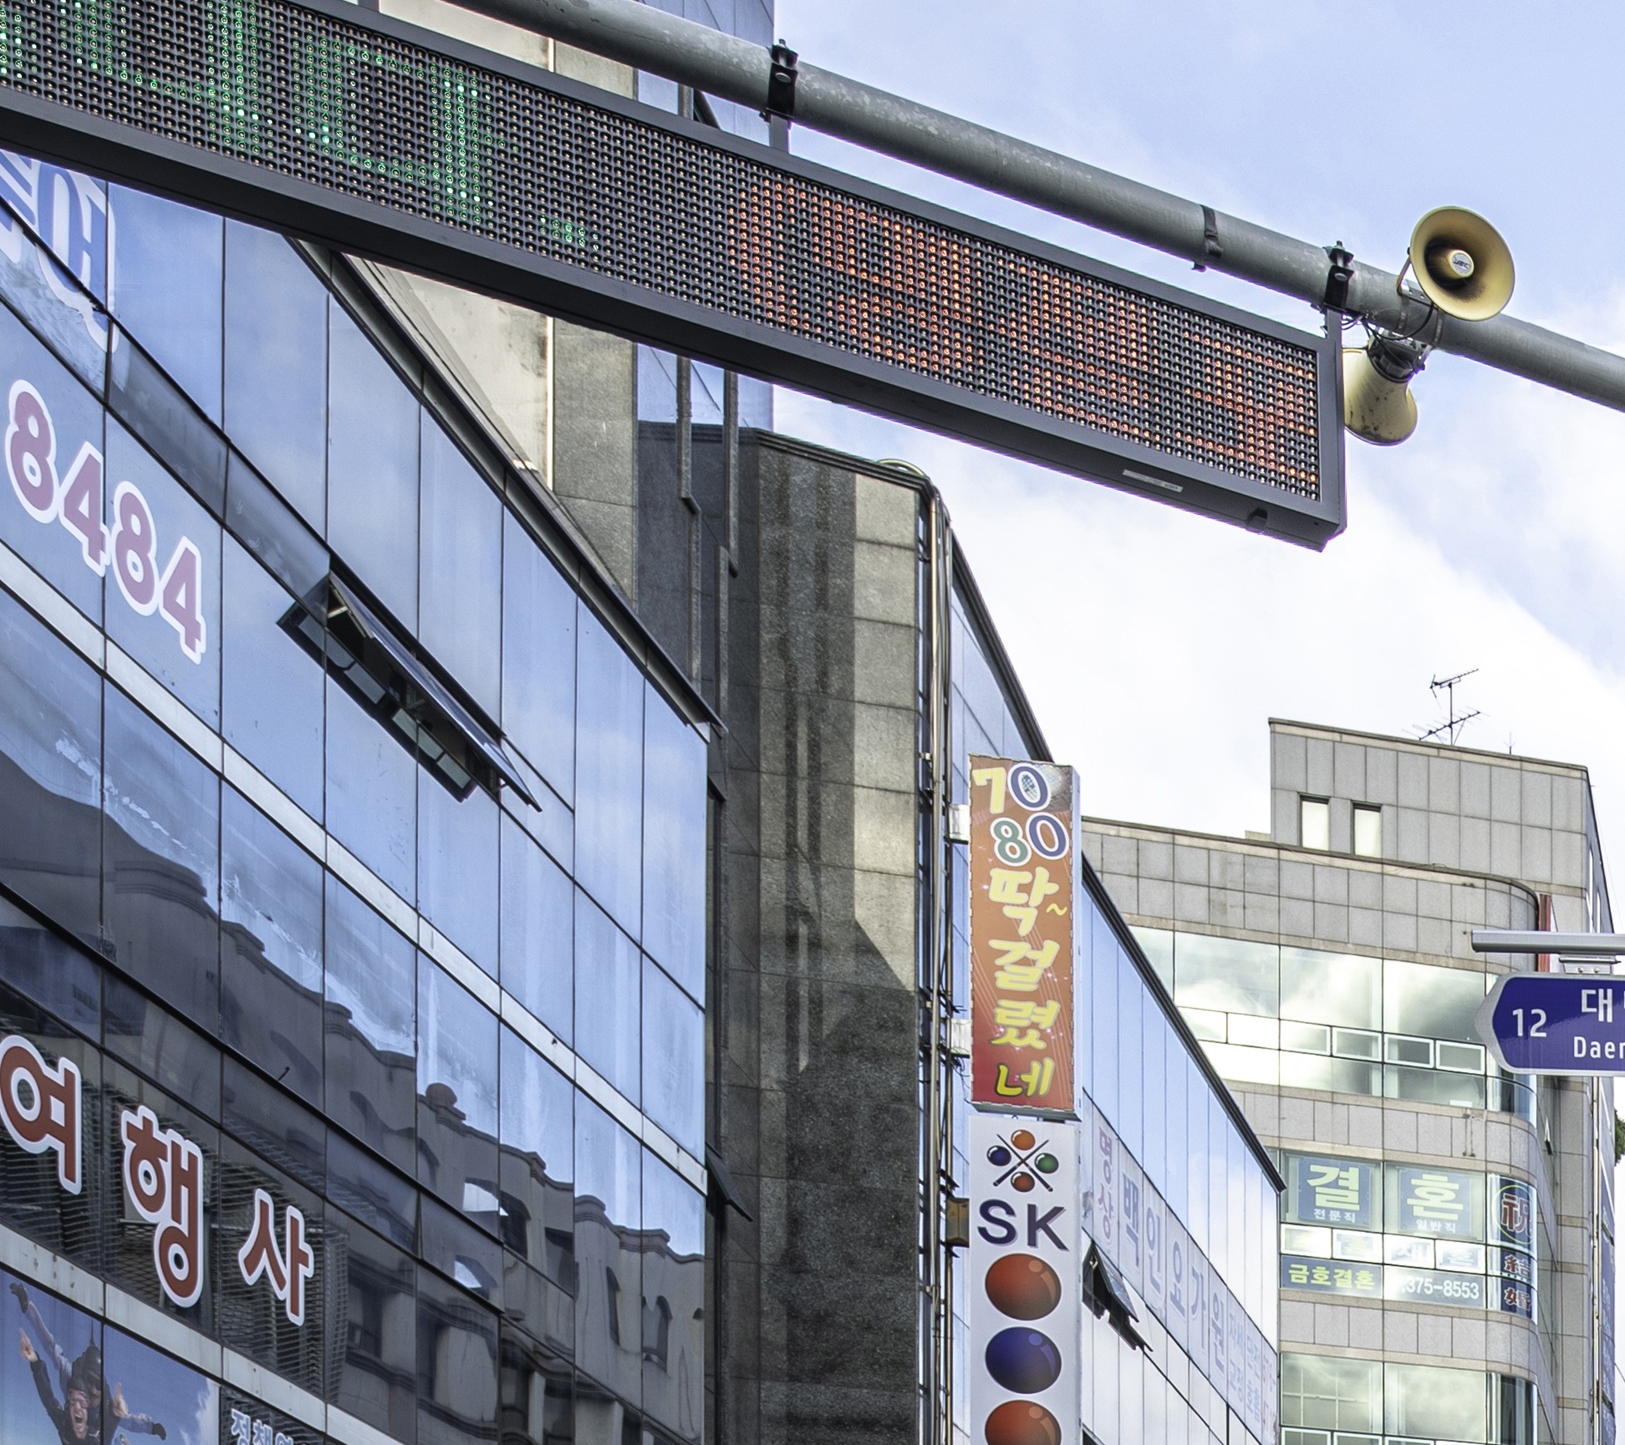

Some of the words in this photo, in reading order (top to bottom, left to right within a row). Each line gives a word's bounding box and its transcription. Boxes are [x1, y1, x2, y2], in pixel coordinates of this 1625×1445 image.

[4, 379, 207, 659] 8484
[972, 762, 1050, 815] 70
[992, 811, 1069, 866] 80
[1512, 1009, 1548, 1038] 12
[0, 1035, 315, 1326] 여행사
[977, 1200, 1069, 1252] SK
[1313, 1208, 1356, 1224] 전문직
[1416, 1219, 1457, 1233] 일반직
[1288, 1263, 1375, 1290] 금호결혼
